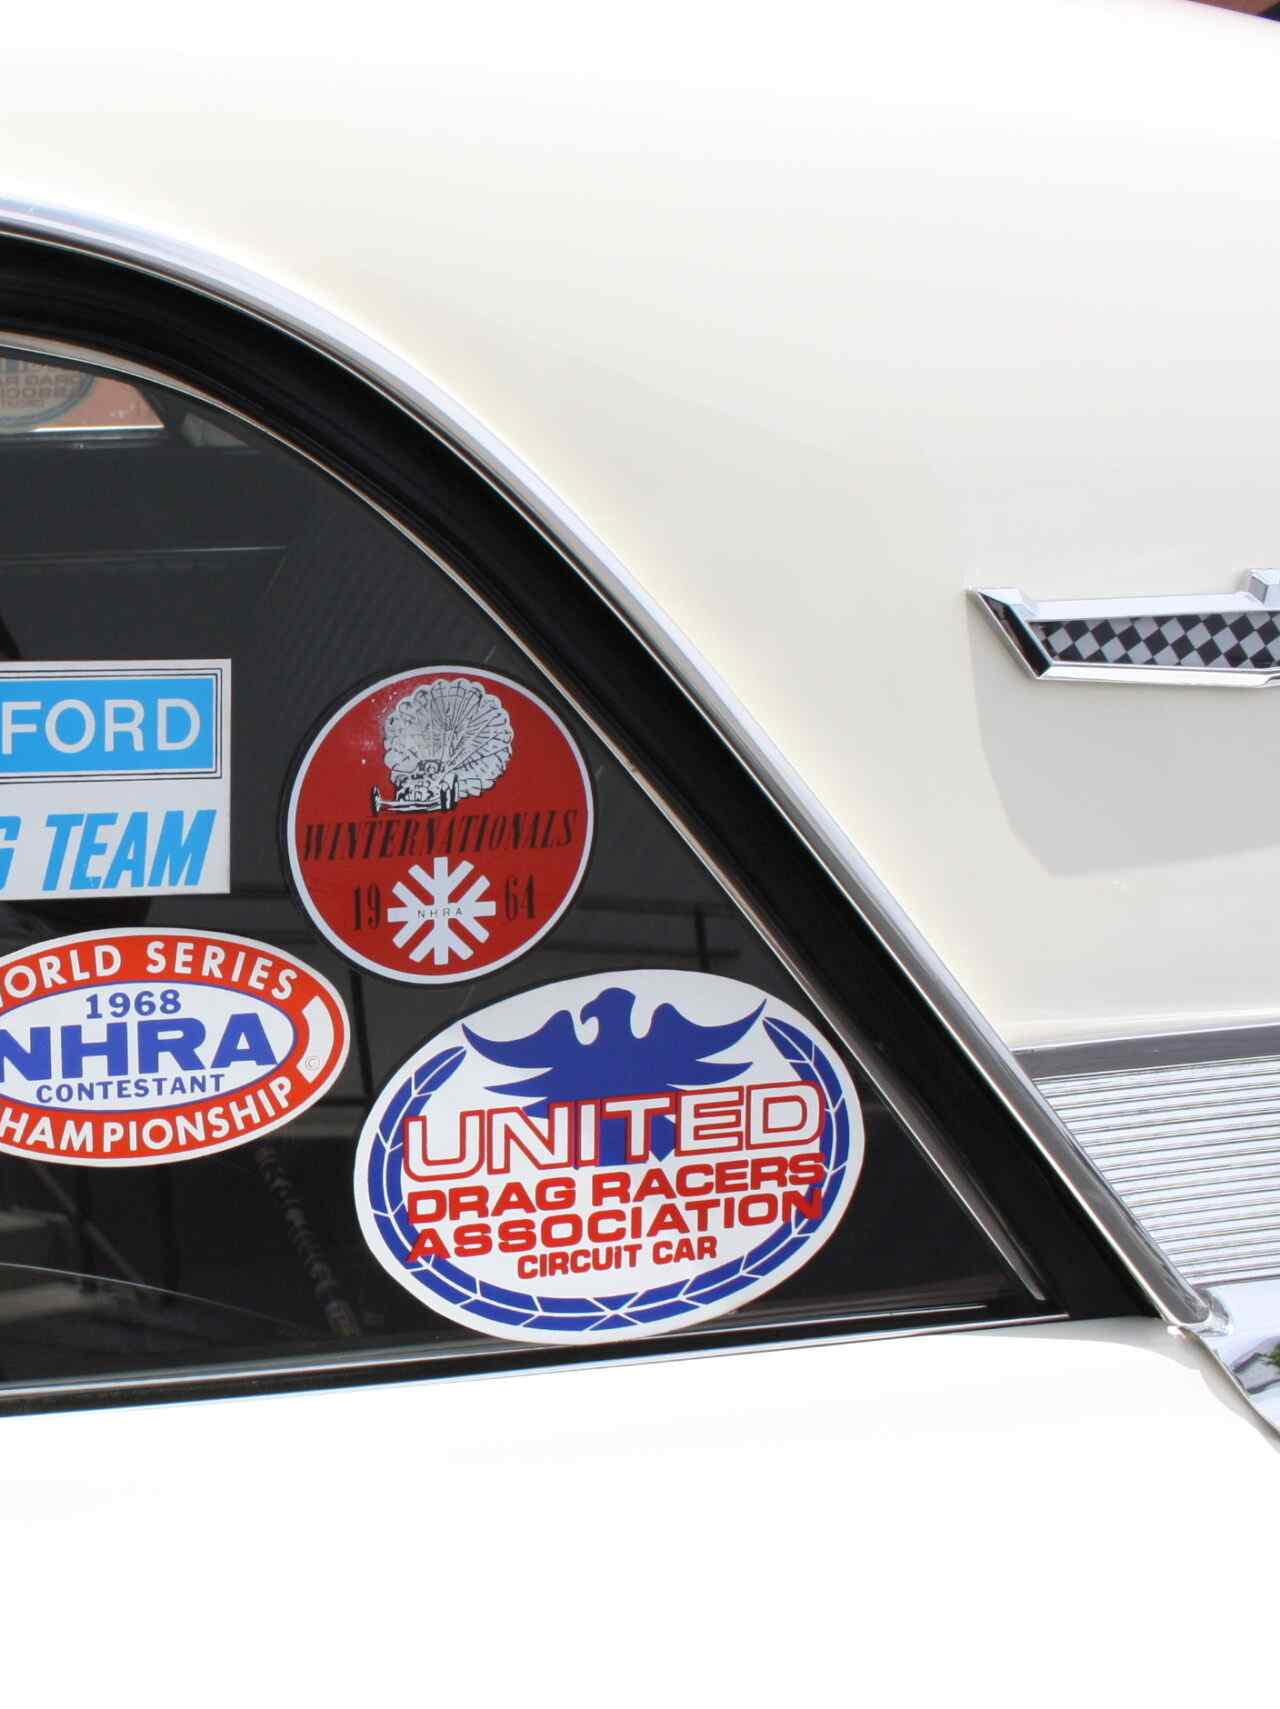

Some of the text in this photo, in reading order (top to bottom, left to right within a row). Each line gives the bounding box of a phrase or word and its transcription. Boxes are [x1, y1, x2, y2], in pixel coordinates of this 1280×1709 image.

[1, 698, 201, 755] FORD
[42, 809, 217, 892] TEAM
[302, 808, 578, 862] WINTERNATIONALS
[352, 874, 536, 930] 19 64
[417, 906, 464, 920] NHRA
[146, 940, 299, 1000] SERIES
[85, 988, 183, 1020] 1968
[36, 1073, 225, 1104] CONTESTANT
[402, 1080, 825, 1182] UNITED
[408, 1151, 825, 1226] DRAG RACERS
[406, 1188, 823, 1262] ASSOCIATION
[517, 1235, 718, 1280] CIRCUIT CAR
